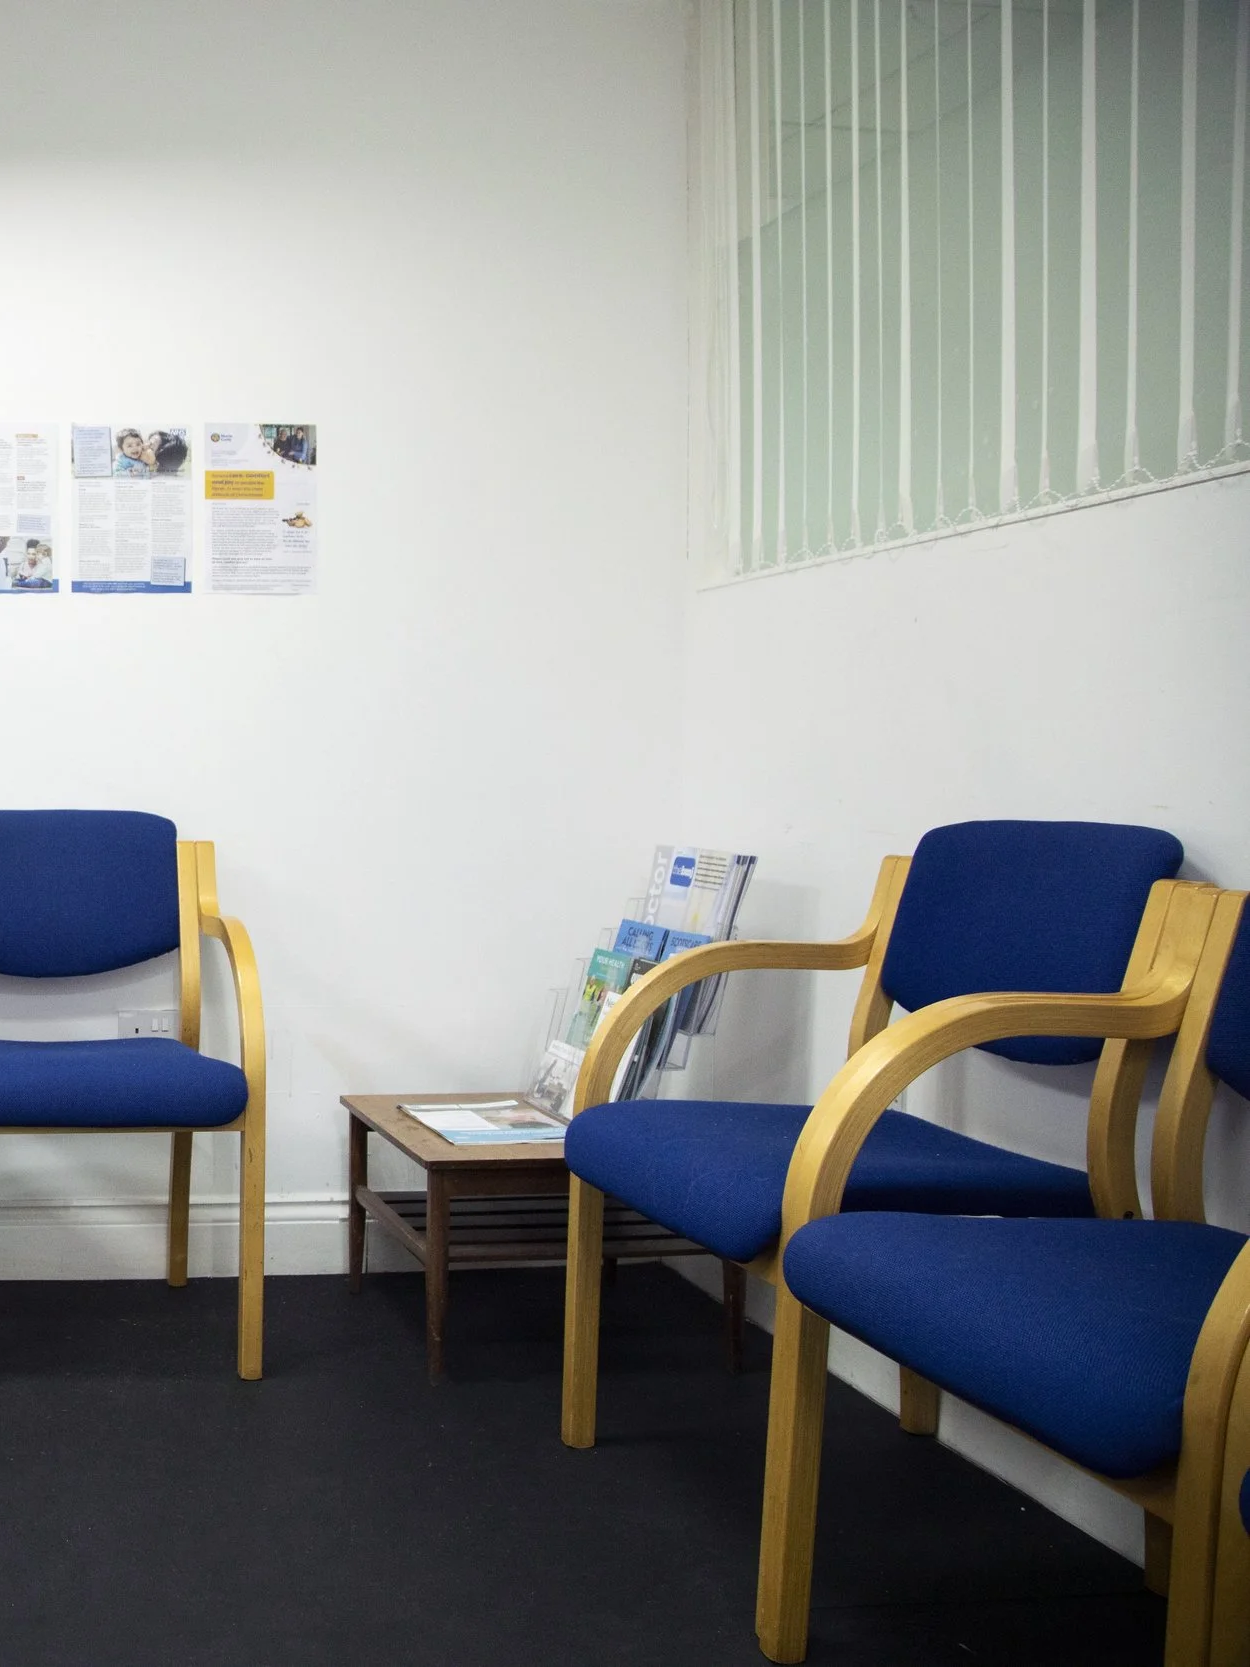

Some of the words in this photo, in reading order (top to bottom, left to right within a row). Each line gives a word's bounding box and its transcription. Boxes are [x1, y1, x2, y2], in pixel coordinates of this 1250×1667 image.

[643, 852, 668, 926] octor
[621, 936, 632, 947] ALL
[597, 955, 609, 965] YOUR
[608, 958, 626, 969] HEALTH
